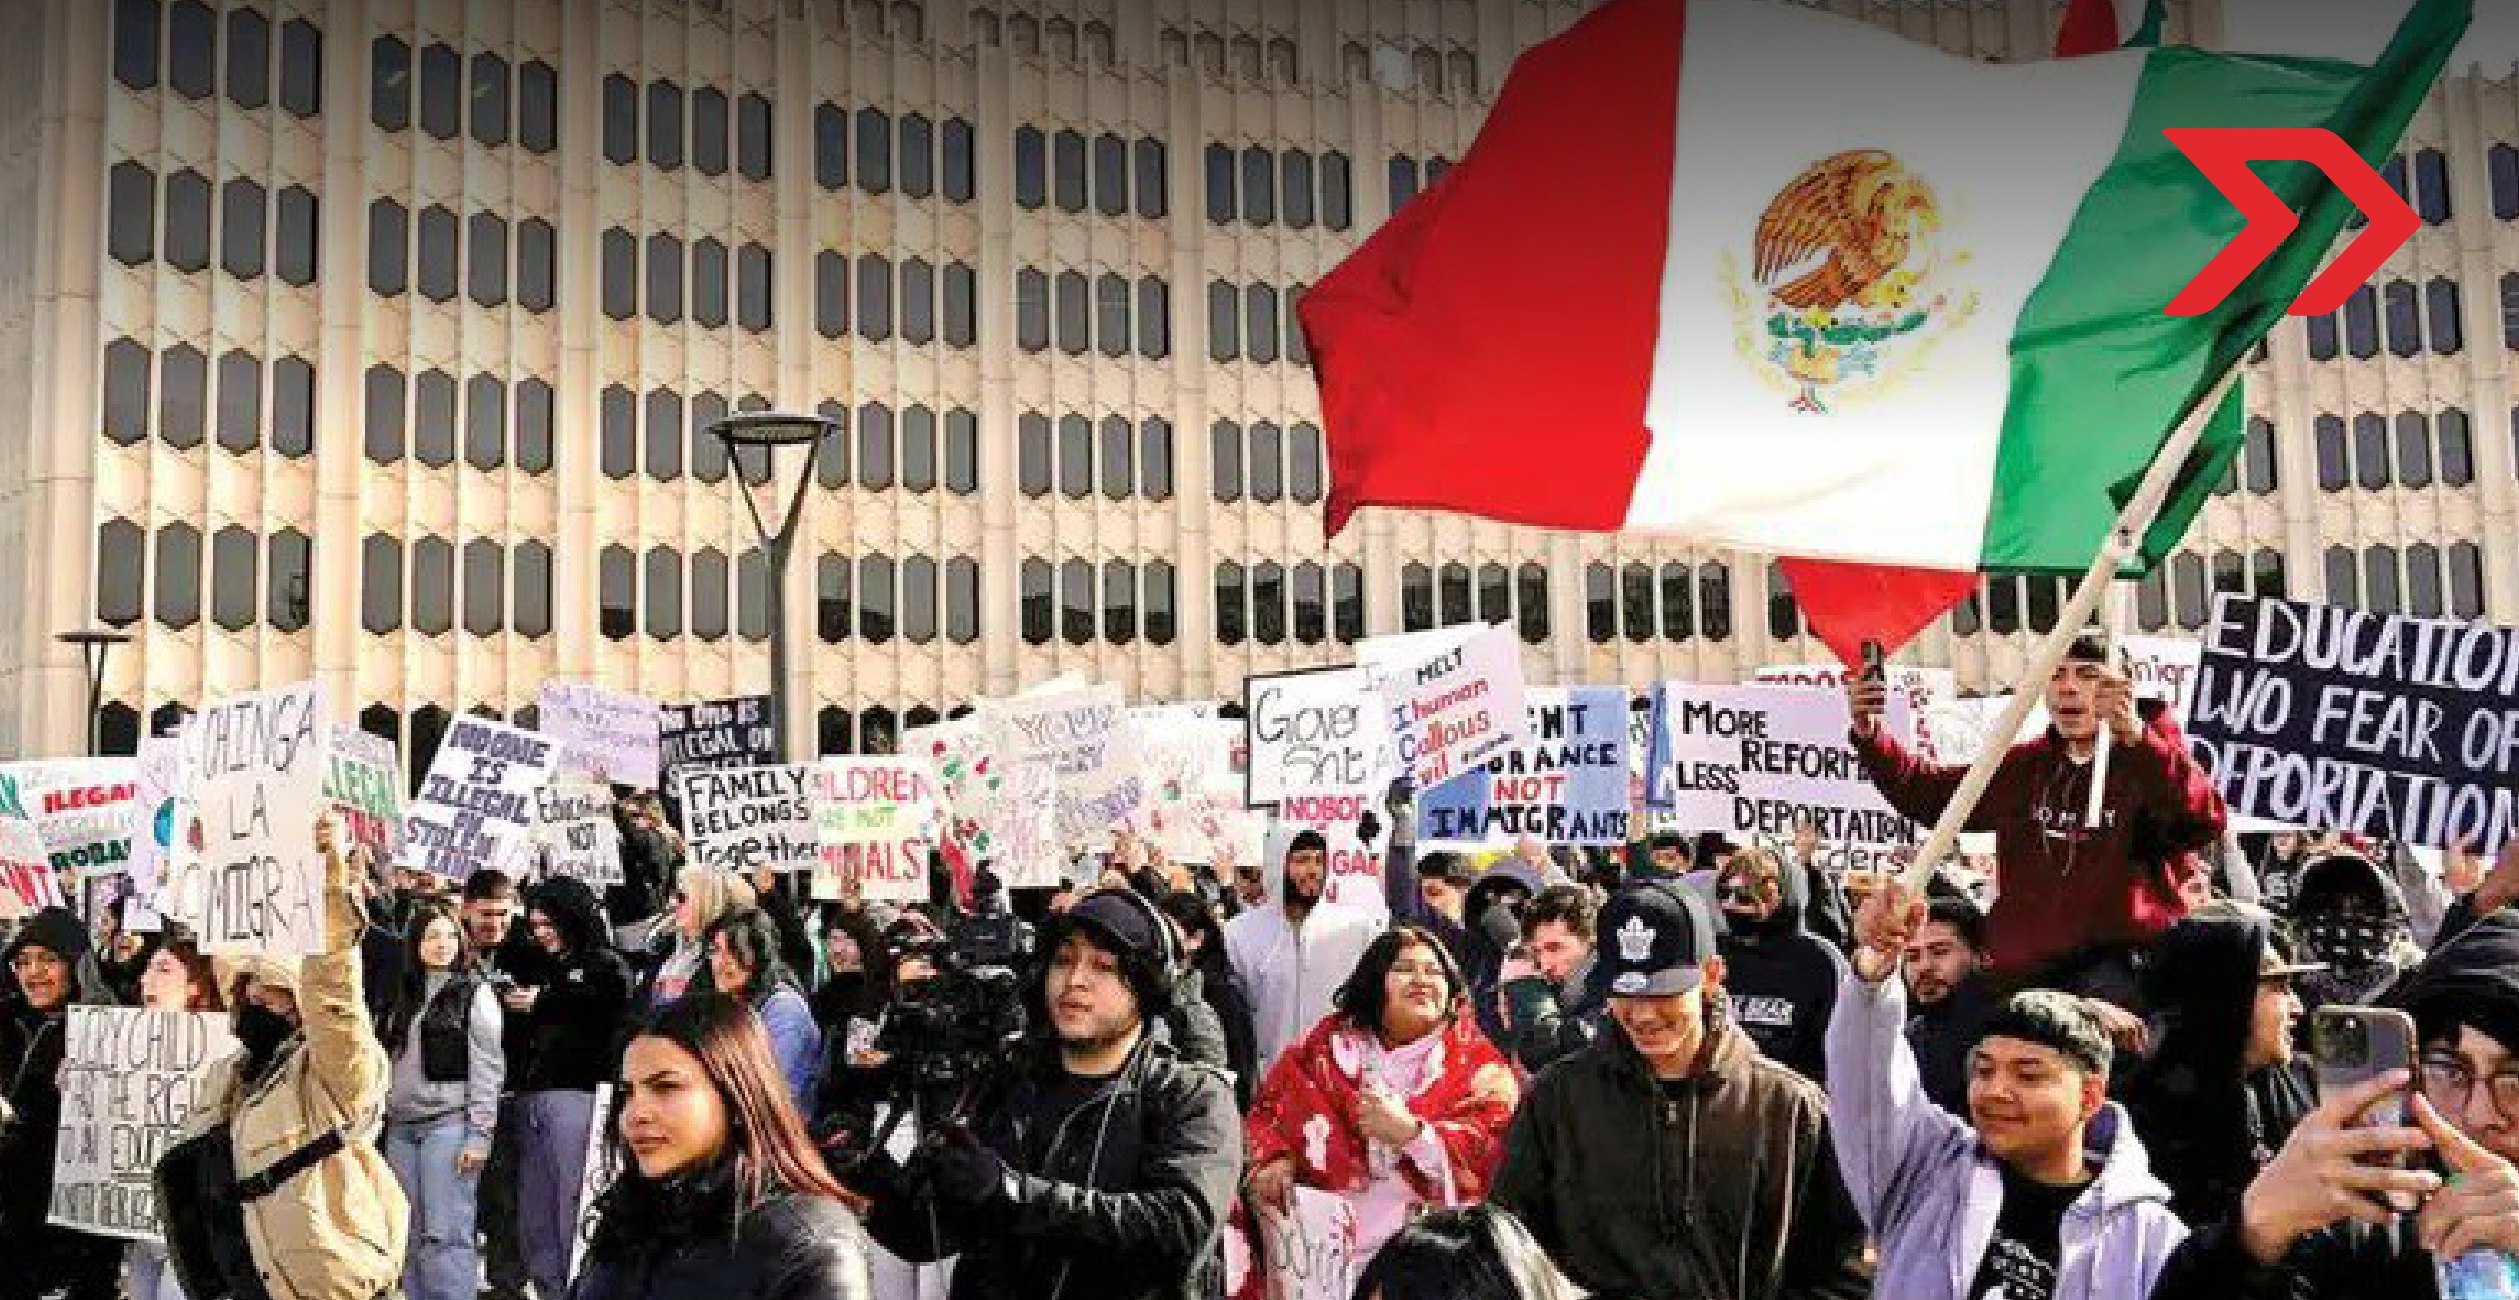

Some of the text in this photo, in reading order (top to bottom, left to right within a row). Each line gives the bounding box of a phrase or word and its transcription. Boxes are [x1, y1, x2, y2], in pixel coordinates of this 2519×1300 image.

[1417, 646, 1463, 685] MELT
[203, 694, 317, 780] CHINGA
[1683, 700, 1767, 739] MORE
[2312, 684, 2443, 764] FEAR
[467, 757, 508, 785] IS
[1478, 743, 1617, 775] ORANCE
[1677, 760, 1740, 795] LESS
[424, 773, 530, 825] ILLEGAL
[685, 766, 807, 811] FAMILY
[1494, 775, 1566, 802] NOT
[229, 780, 270, 841] LA
[691, 797, 811, 837] BELONGS
[1430, 805, 1627, 841] IMMIGRANTS
[206, 855, 316, 949] MIGRA
